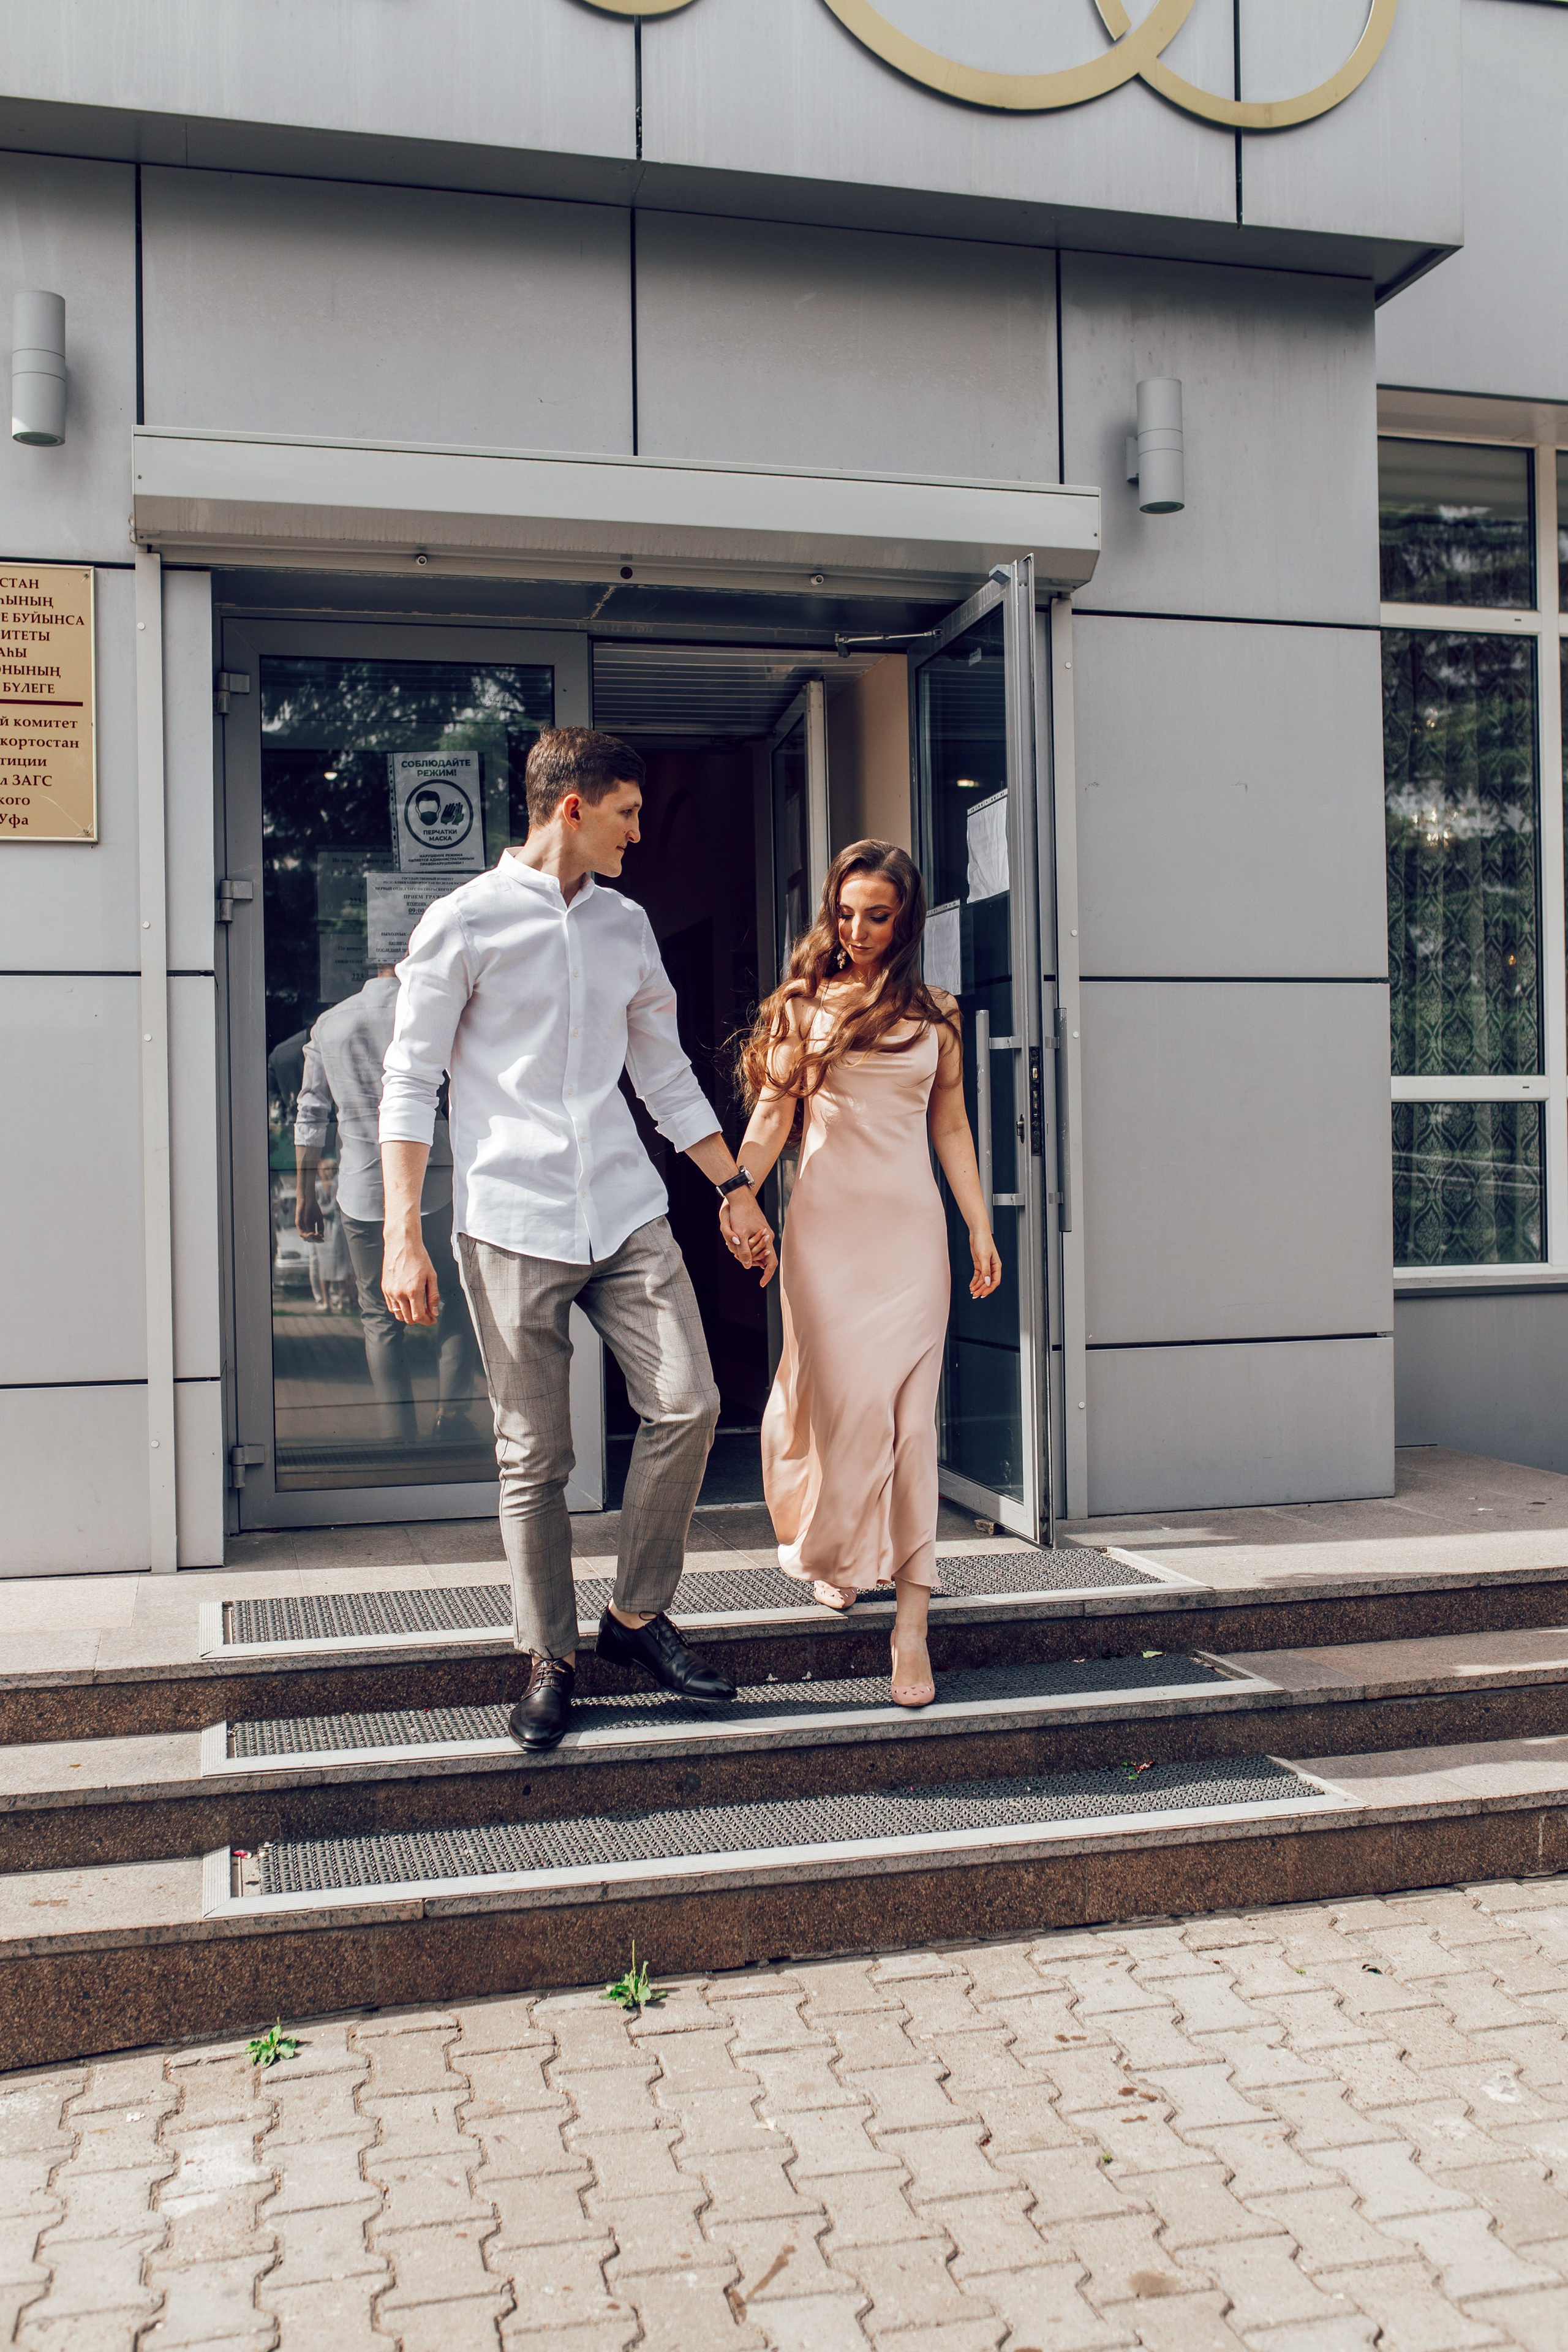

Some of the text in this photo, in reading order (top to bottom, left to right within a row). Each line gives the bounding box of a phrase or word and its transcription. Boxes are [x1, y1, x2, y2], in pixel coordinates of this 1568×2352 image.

[0, 578, 39, 589] СТАН
[13, 611, 85, 625] БУЙЫНСА
[1, 630, 50, 641] ИТЕТЫ
[0, 665, 61, 679] НЫНЫҢ
[13, 718, 78, 728] комитет
[0, 738, 79, 750] кортостан
[0, 758, 47, 768] тиции
[401, 758, 471, 767] СОБЛЮДАЙТЕ
[12, 774, 52, 786] ЗАГС
[0, 813, 29, 829] Уфа
